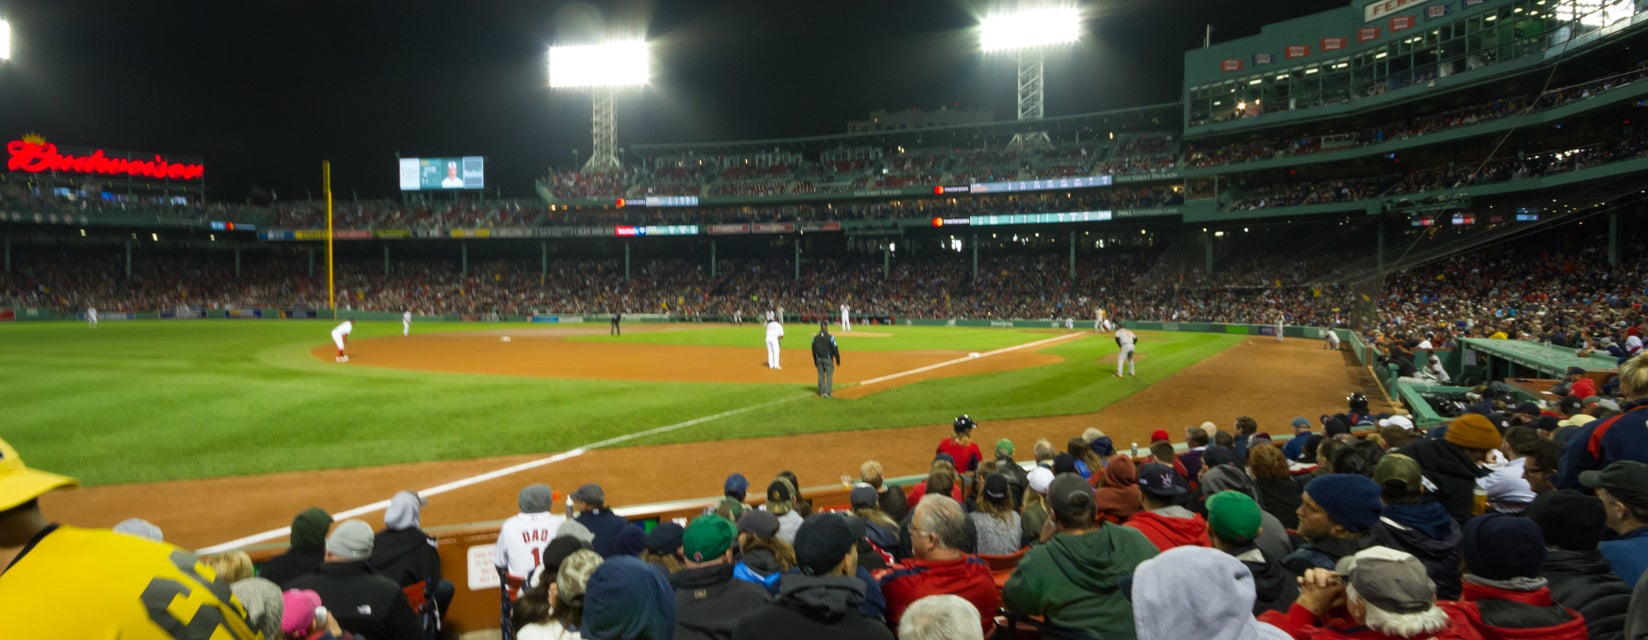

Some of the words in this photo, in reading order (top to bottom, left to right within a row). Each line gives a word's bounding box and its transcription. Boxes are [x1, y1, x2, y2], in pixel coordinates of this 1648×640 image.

[7, 141, 204, 180] Budweiser
[522, 528, 548, 543] DAD
[531, 547, 541, 567] 1
